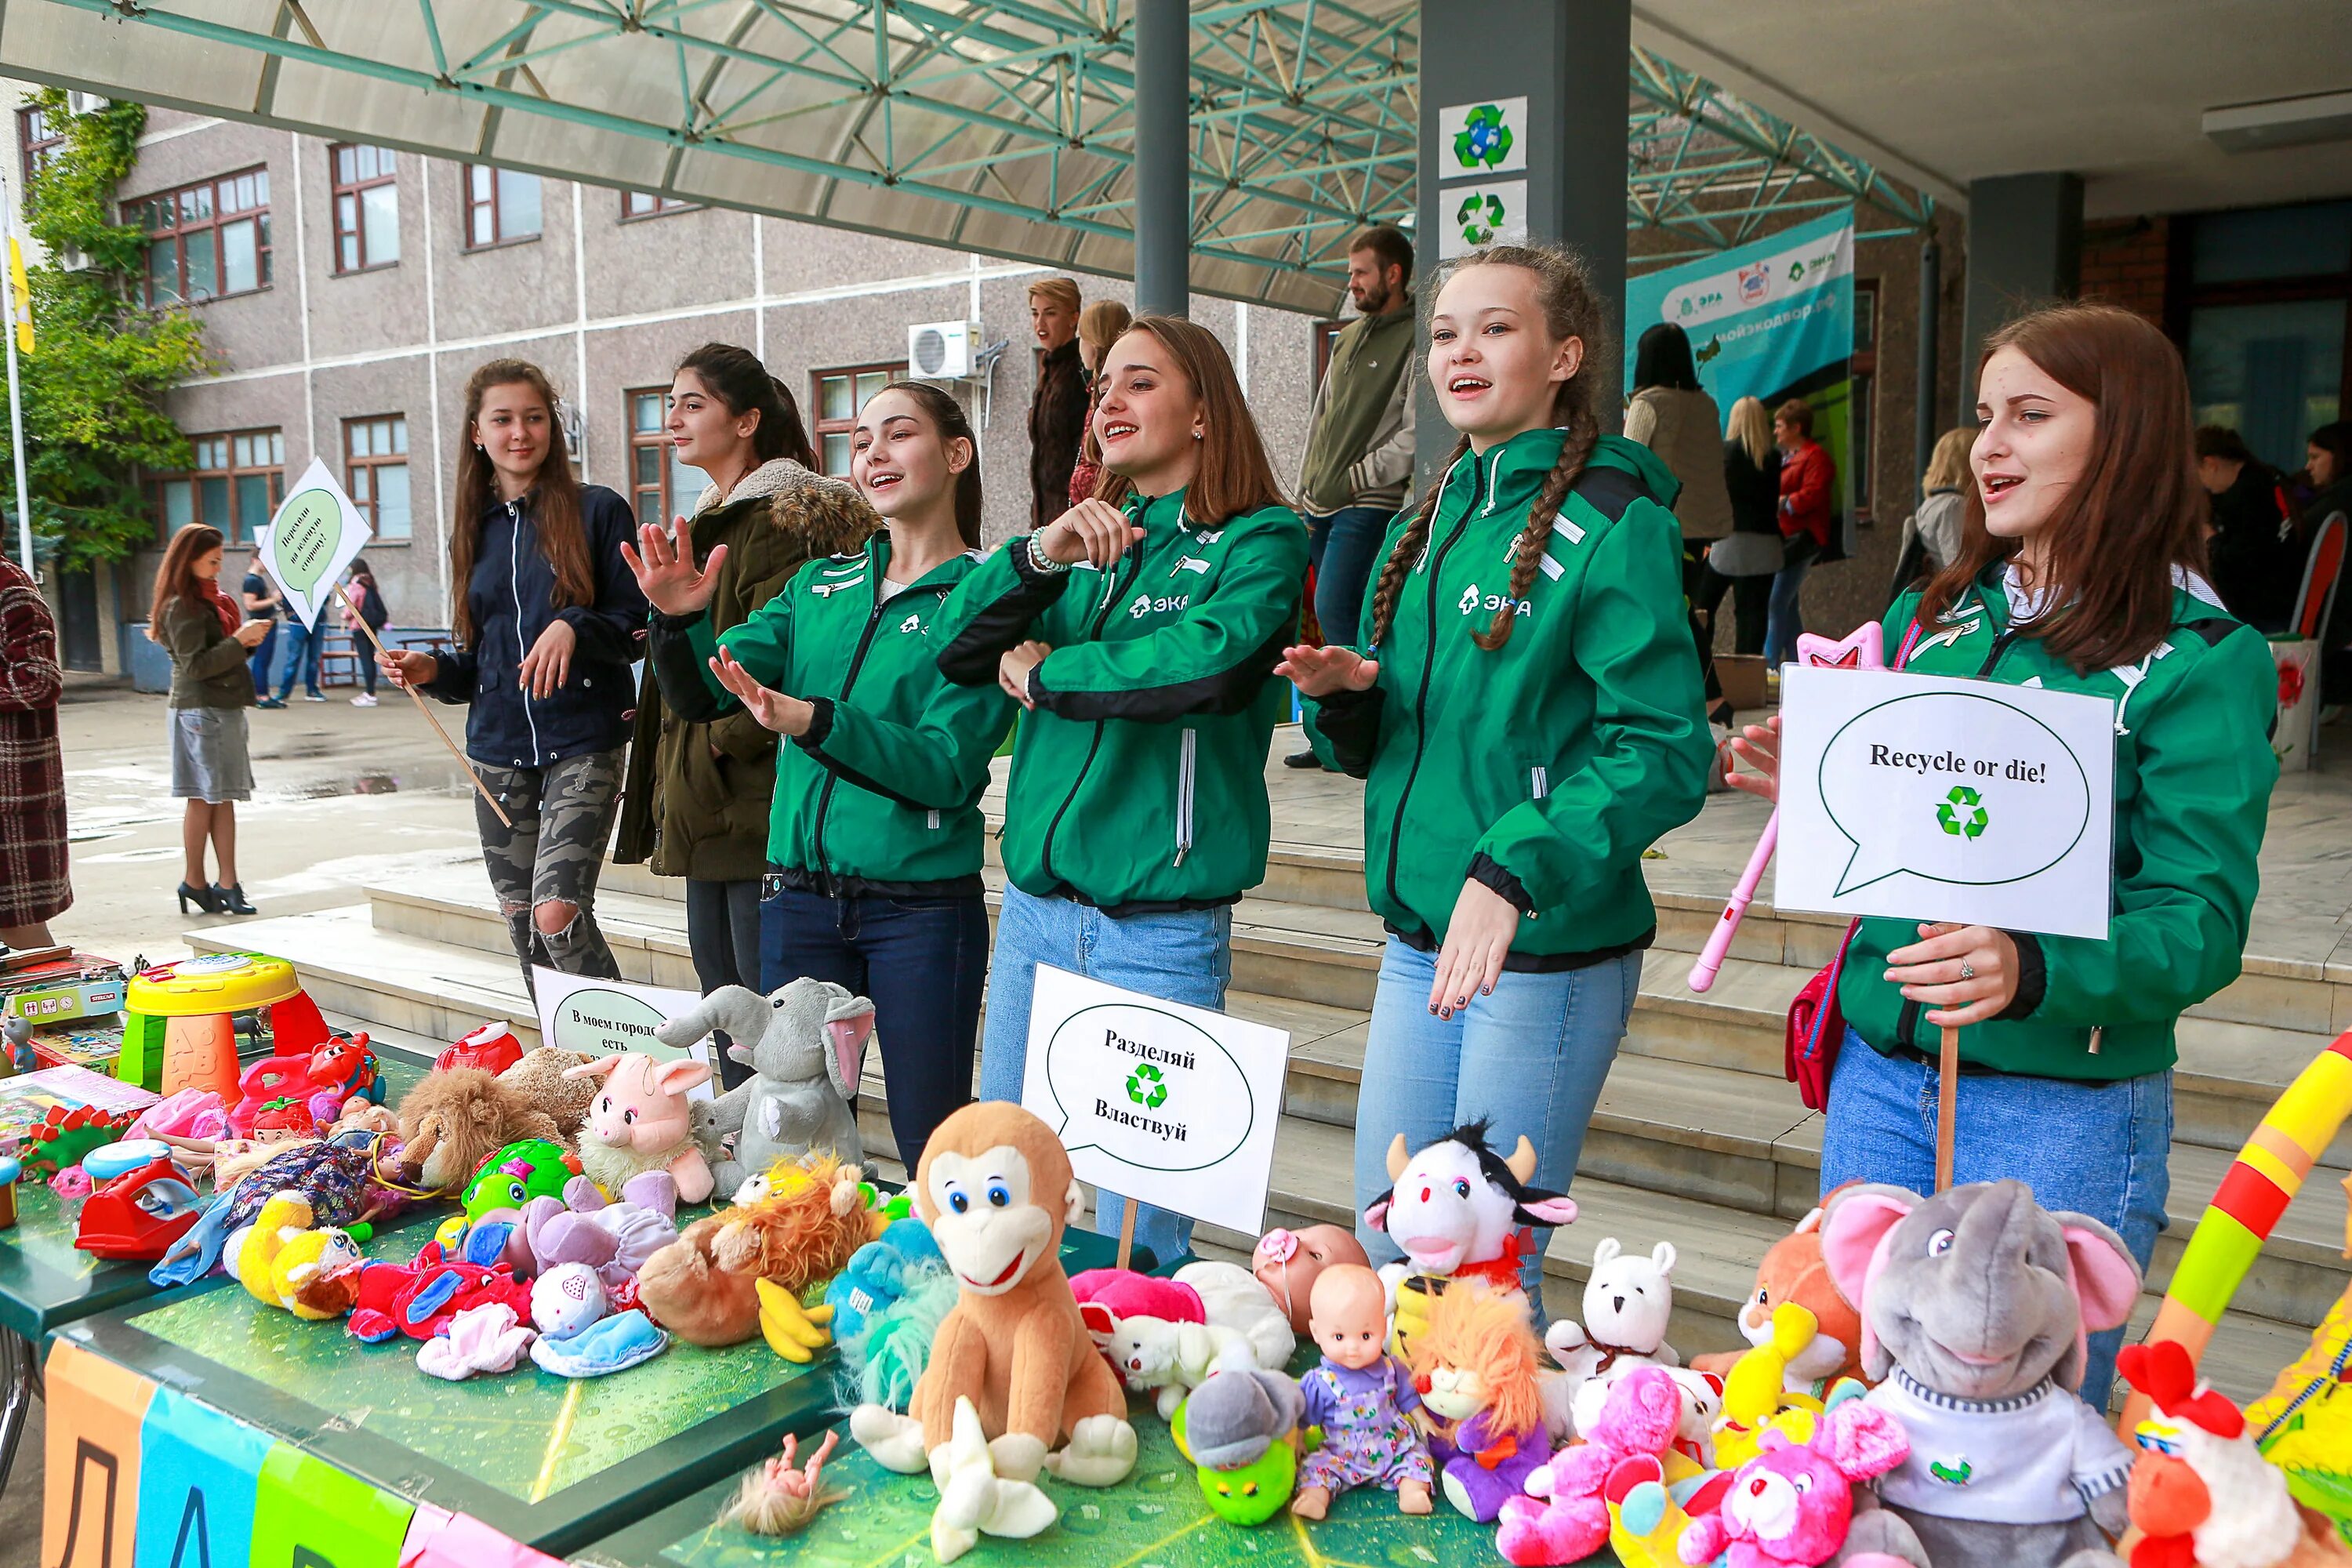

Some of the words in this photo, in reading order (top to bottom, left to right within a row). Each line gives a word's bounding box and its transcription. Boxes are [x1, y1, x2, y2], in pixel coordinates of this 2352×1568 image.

[1699, 292, 1722, 306] ЭРА
[282, 508, 310, 547] Переходи
[291, 553, 299, 564] на
[298, 517, 321, 551] зеленую
[302, 533, 326, 572] сторону!
[1153, 594, 1189, 612] ЭКА
[1869, 743, 1966, 775] Recycle
[1973, 759, 1999, 777] or
[2005, 758, 2046, 784] die!
[572, 1009, 581, 1022] В
[583, 1014, 612, 1030] моем
[601, 1038, 628, 1051] есть
[1105, 1028, 1196, 1071] Разделяй
[1094, 1098, 1187, 1142] Властвуй
